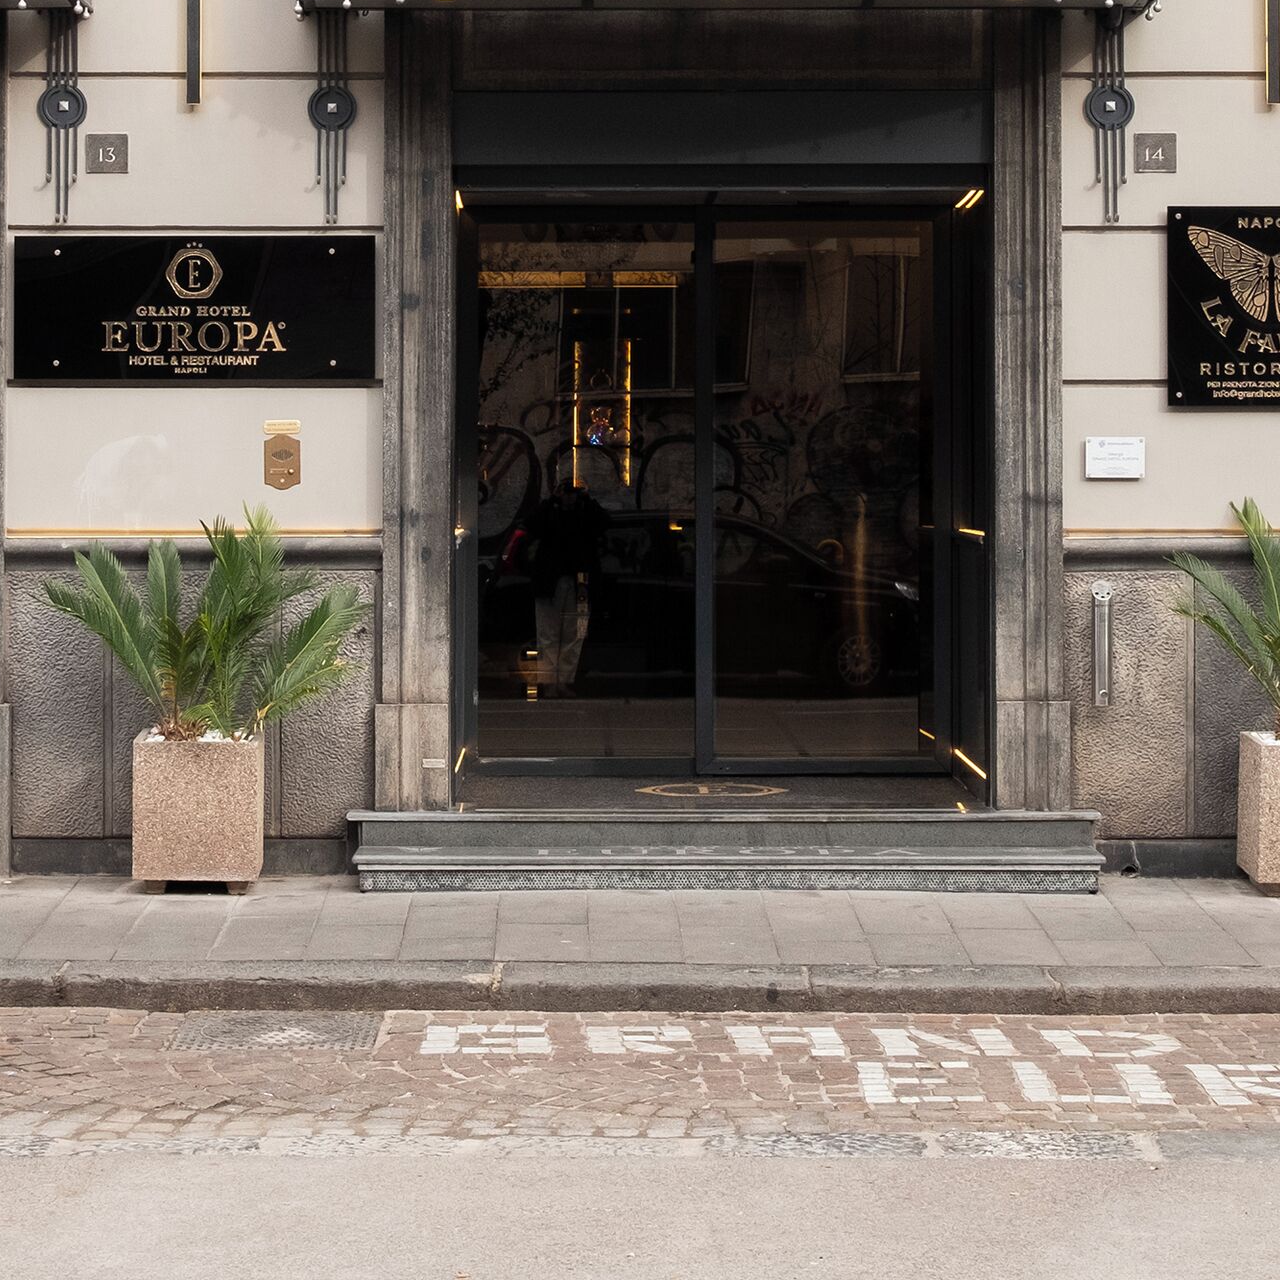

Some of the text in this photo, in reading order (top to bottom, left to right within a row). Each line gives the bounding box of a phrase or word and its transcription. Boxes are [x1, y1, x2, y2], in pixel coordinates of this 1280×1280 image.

[99, 147, 116, 163] 13
[1144, 147, 1165, 162] 14
[187, 259, 202, 289] E
[135, 305, 251, 317] GRAND HOTEL
[1200, 296, 1234, 338] LA
[101, 320, 287, 353] EUROPA
[129, 355, 260, 366] HOTEL & RESTAURANT
[419, 1024, 1182, 1058] GRAND
